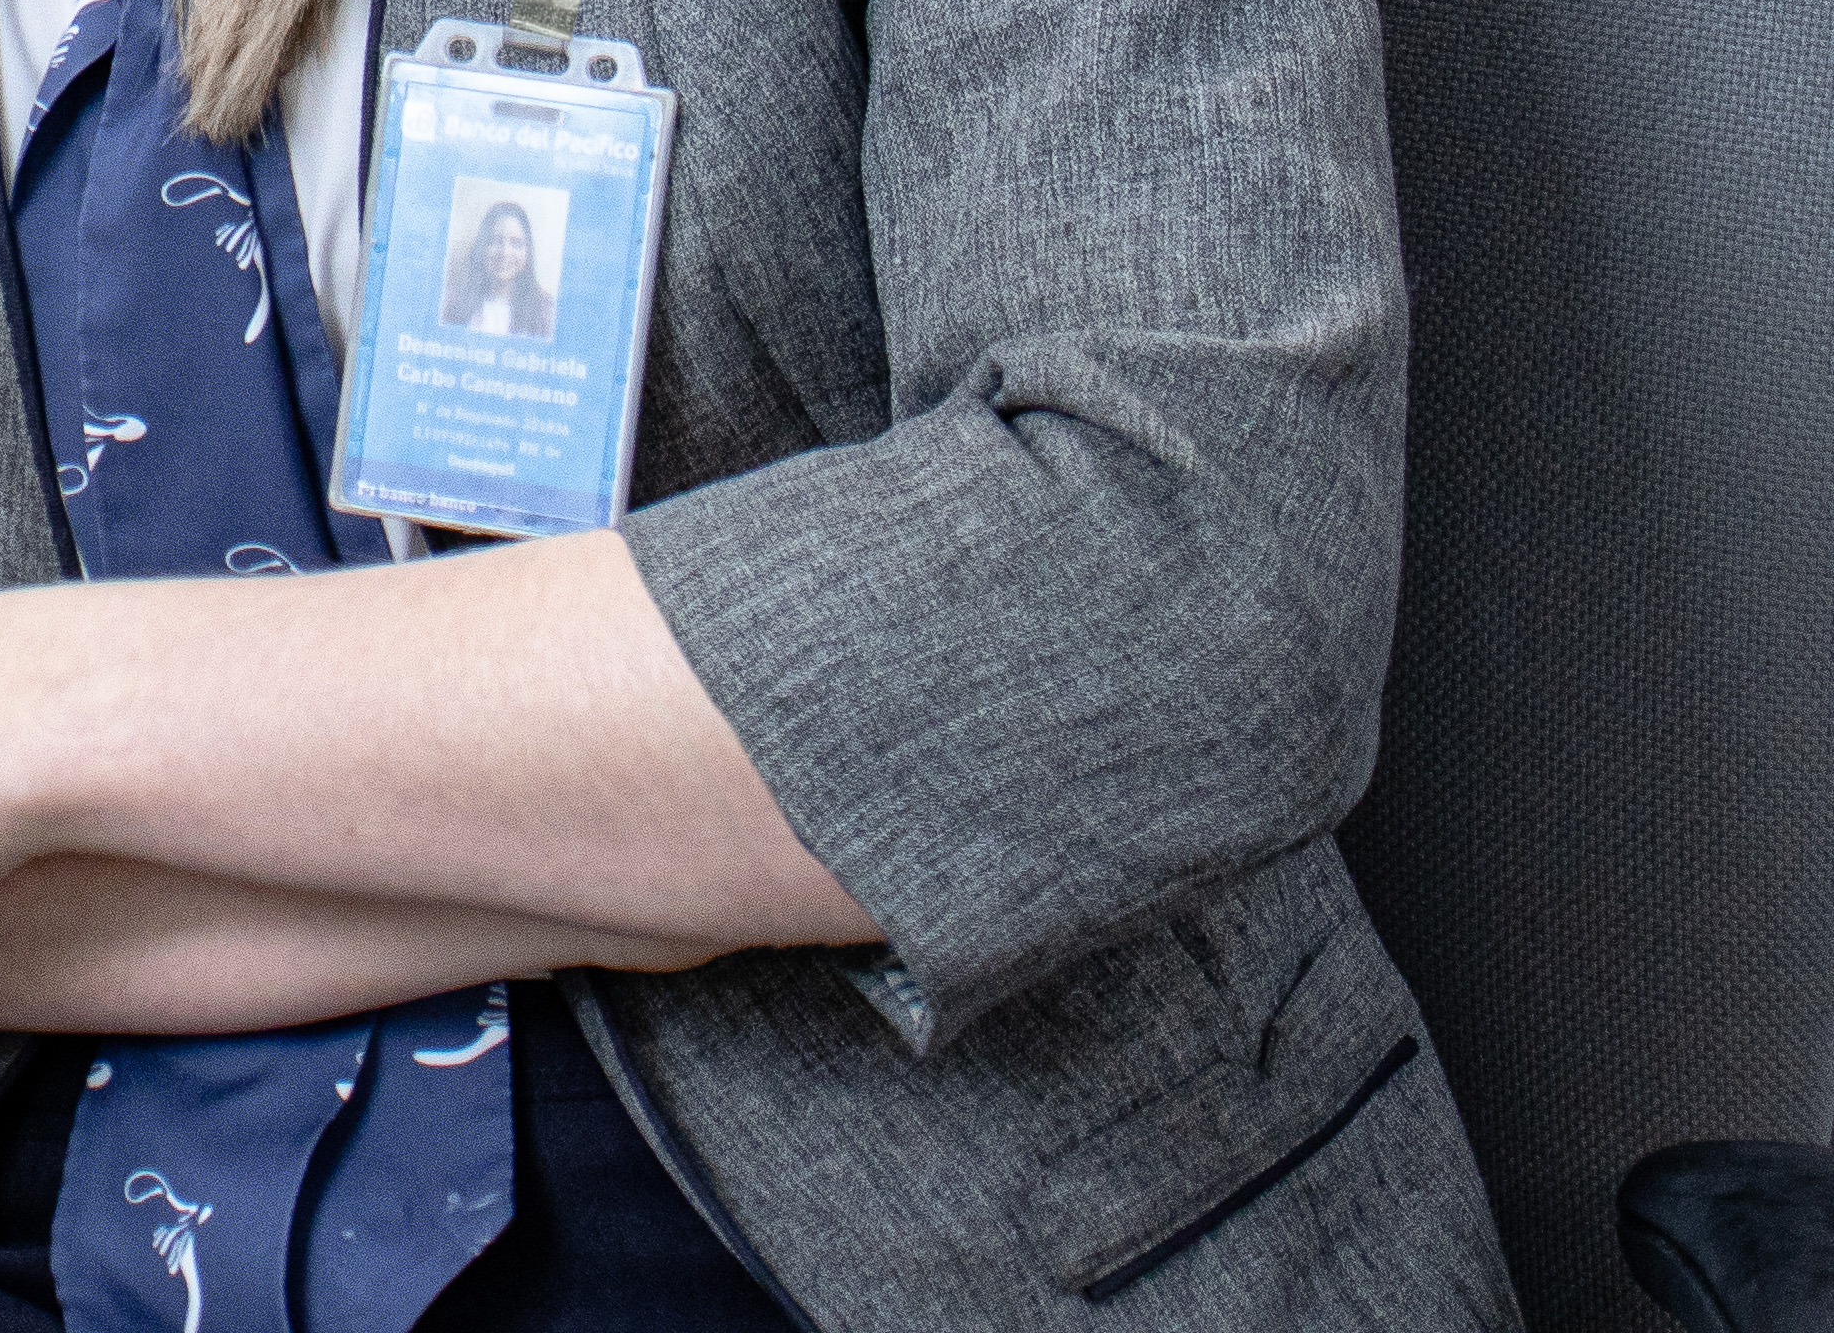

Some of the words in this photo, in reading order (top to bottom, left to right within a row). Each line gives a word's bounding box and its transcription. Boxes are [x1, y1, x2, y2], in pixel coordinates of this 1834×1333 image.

[444, 115, 511, 144] Banco
[516, 122, 550, 150] del
[502, 348, 588, 380] Gabriela
